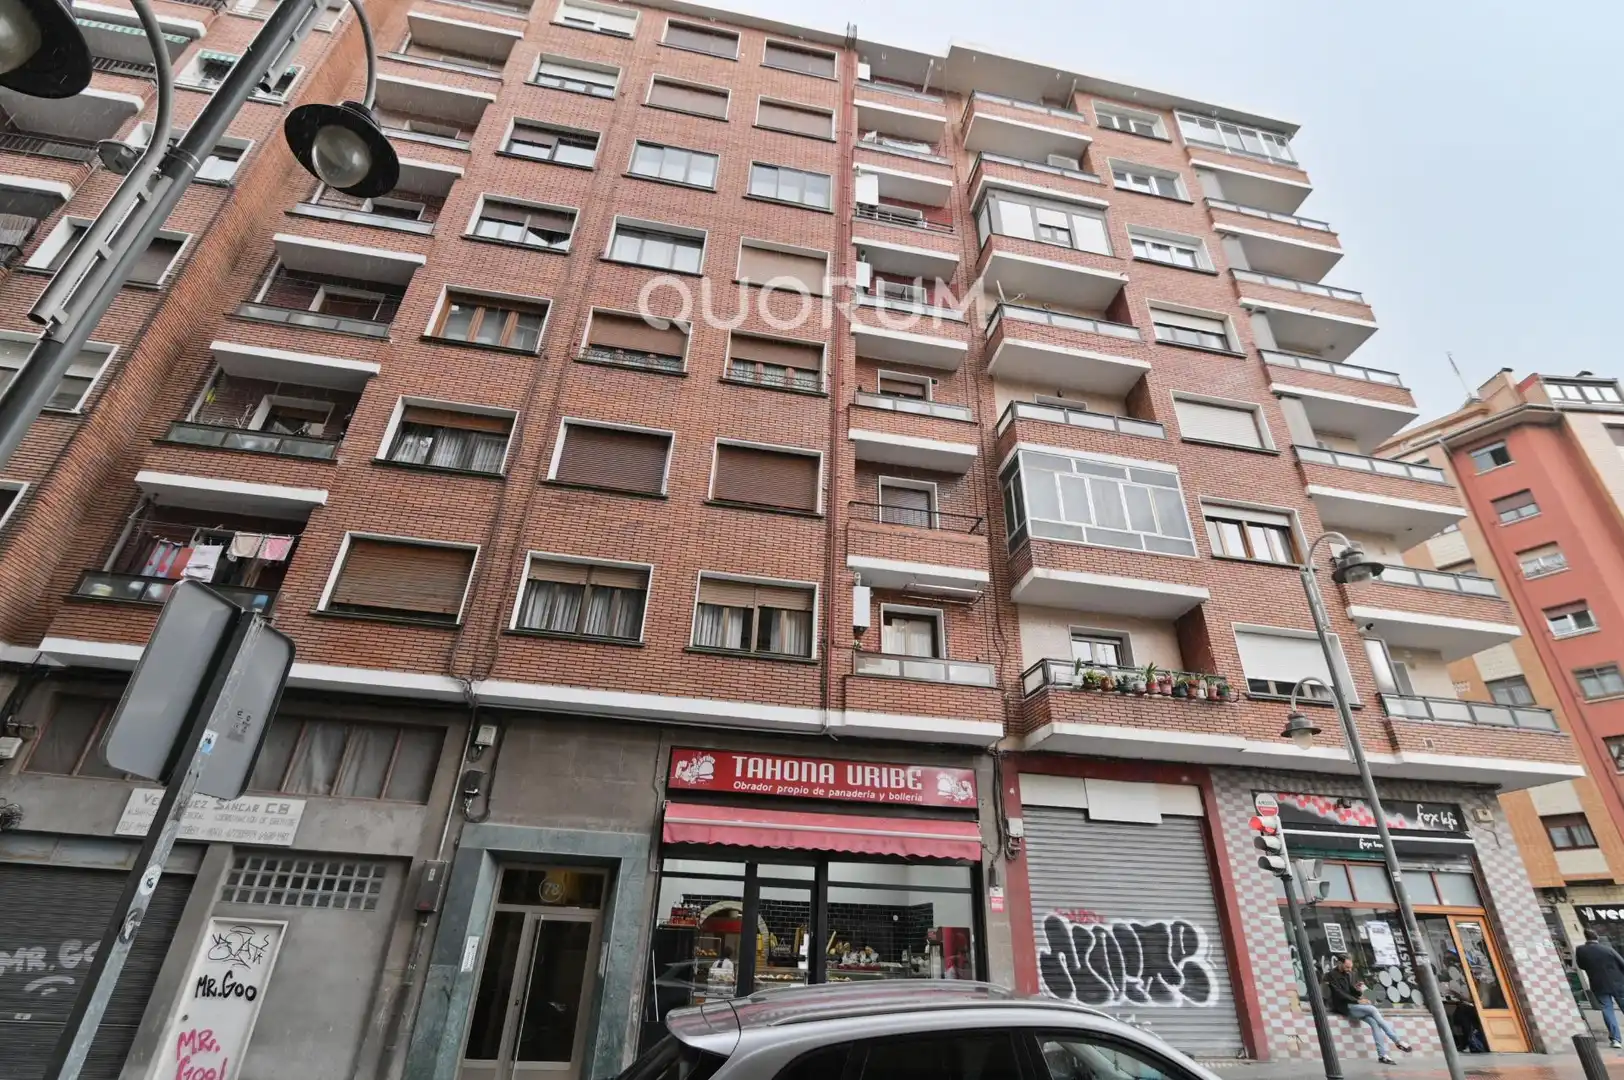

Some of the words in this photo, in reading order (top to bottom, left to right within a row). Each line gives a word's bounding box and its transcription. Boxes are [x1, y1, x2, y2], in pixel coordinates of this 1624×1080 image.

[732, 756, 835, 785] TAHONA
[847, 764, 923, 790] URIBE
[733, 781, 773, 792] Obrador
[777, 785, 809, 795] propio
[812, 787, 825, 796] de
[879, 792, 886, 801] y
[544, 882, 560, 896] 78
[1393, 927, 1419, 985] AMSTEL
